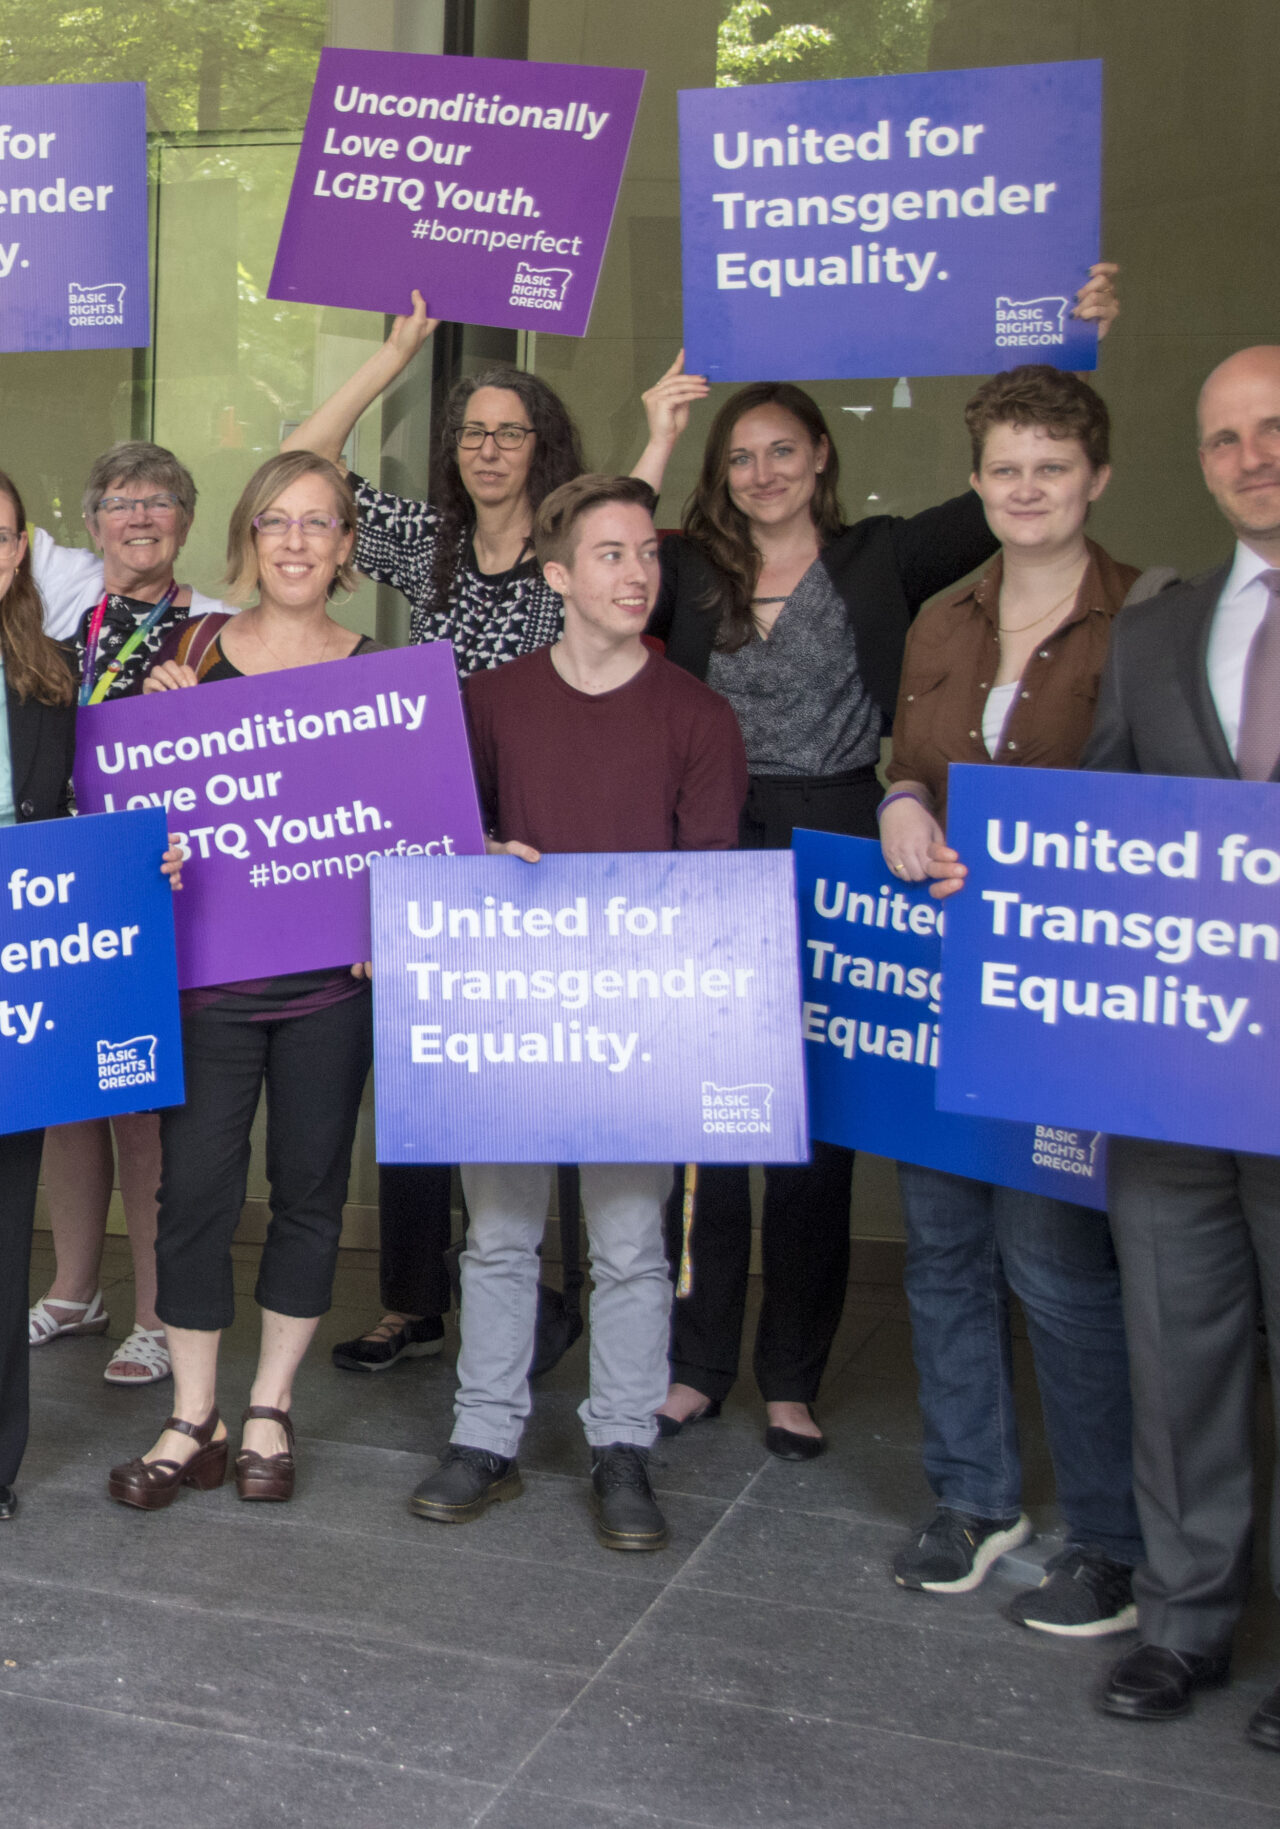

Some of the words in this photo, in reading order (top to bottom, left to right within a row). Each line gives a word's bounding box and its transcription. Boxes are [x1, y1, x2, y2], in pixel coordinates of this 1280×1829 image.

[334, 85, 610, 140] Unconditionally
[323, 128, 399, 159] Love
[406, 136, 473, 166] Our
[714, 120, 889, 169] United
[906, 118, 984, 158] for
[314, 170, 425, 211] LGBTQ
[435, 181, 540, 218] Youth.
[713, 176, 1055, 232] Transgender
[411, 219, 582, 256] #bornperfect
[514, 273, 552, 287] BASIC
[717, 243, 949, 297] Equality.
[69, 294, 107, 304] BASIC
[509, 296, 562, 311] OREGON
[512, 284, 557, 299] RIGHTS
[69, 304, 116, 315] RIGHTS
[69, 315, 124, 326] OREGON
[996, 309, 1043, 321] BASIC
[996, 321, 1054, 333] RIGHTS
[996, 334, 1064, 346] OREGON
[96, 691, 426, 774] Unconditionally
[206, 771, 282, 805] Our
[254, 800, 392, 847] Youth.
[987, 819, 1199, 879] United
[1218, 834, 1280, 885] fo
[8, 868, 75, 910] for
[407, 896, 587, 937] United
[605, 897, 681, 936] for
[814, 878, 944, 937] Unite
[982, 890, 1280, 964] Transgen
[406, 959, 754, 1009] Transgender
[981, 962, 1263, 1044] Equality.
[411, 1020, 651, 1073] Equality.
[802, 1001, 939, 1068] Equali
[98, 1049, 139, 1066] BASIC
[98, 1059, 147, 1077] RIGHTS
[99, 1071, 156, 1090] OREGON
[702, 1095, 749, 1106] BASIC
[703, 1108, 761, 1120] RIGHTS
[703, 1121, 771, 1133] OREGON
[1035, 1125, 1077, 1145] BASIC
[1032, 1152, 1093, 1177] OREGON
[1033, 1139, 1086, 1161] RIGHTS
